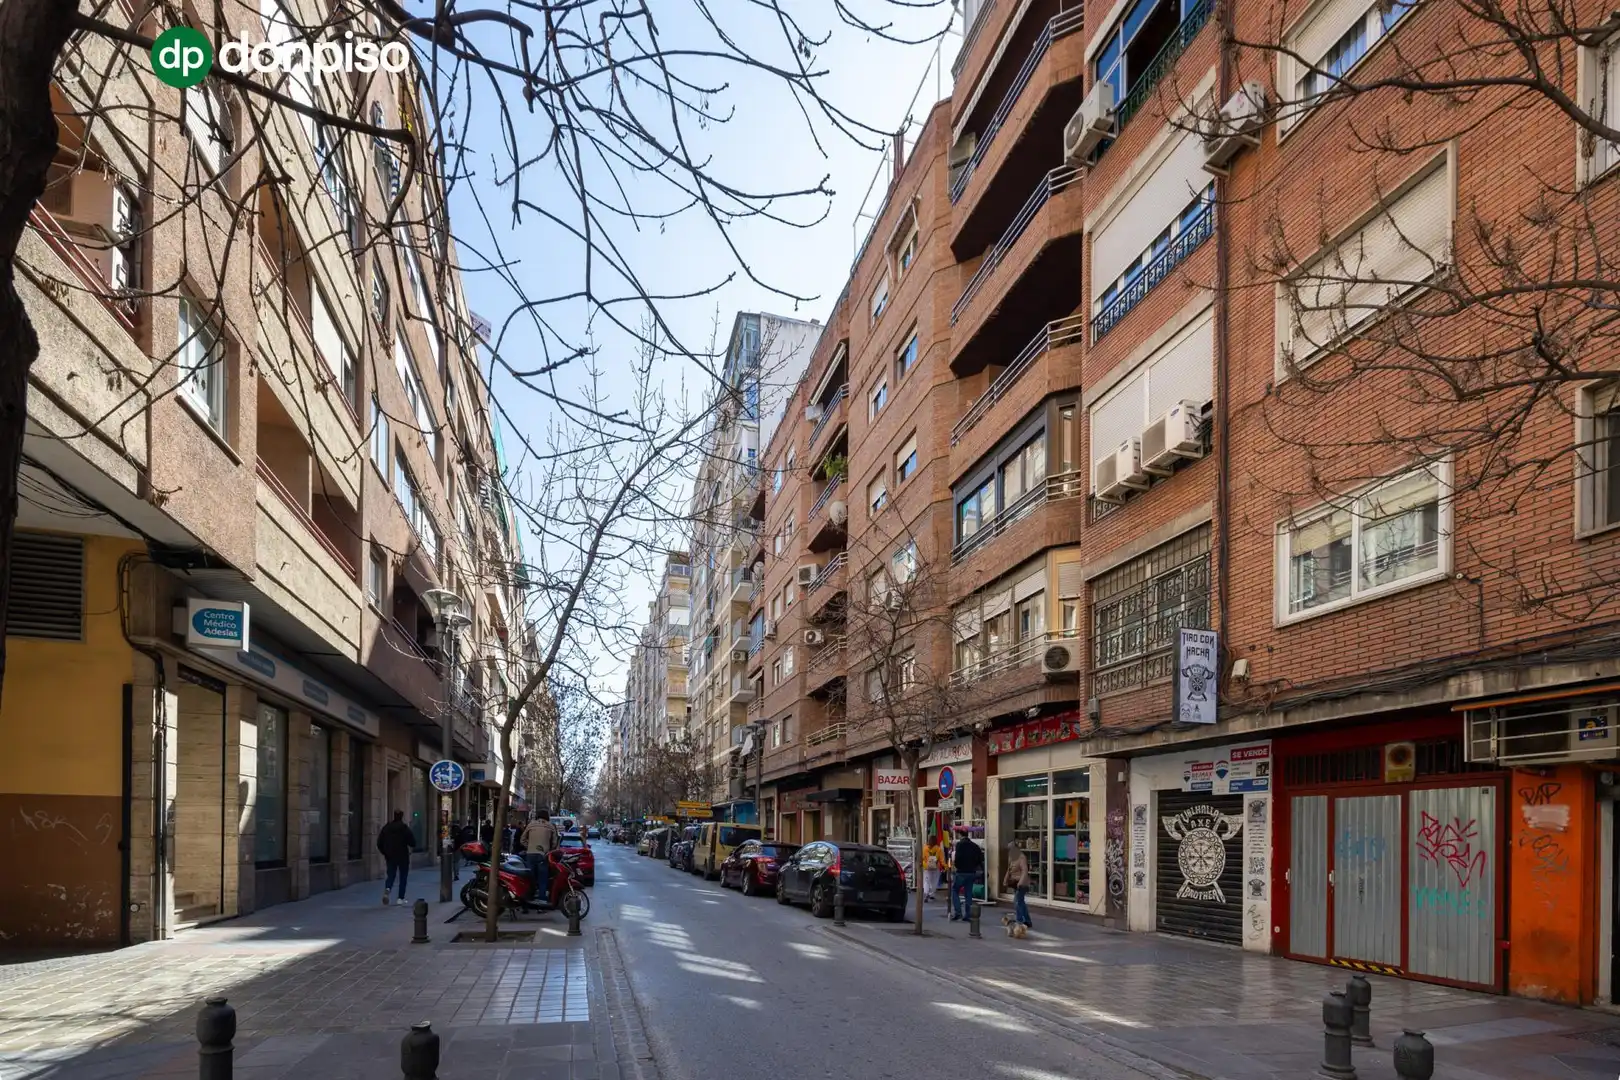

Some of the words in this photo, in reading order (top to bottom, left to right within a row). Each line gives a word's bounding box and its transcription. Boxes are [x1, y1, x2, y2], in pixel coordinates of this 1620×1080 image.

[204, 611, 235, 620] Centro
[204, 619, 236, 628] Médico
[204, 628, 238, 637] Adeslas
[1199, 634, 1215, 648] CON
[1186, 646, 1210, 661] HACHA
[1232, 751, 1242, 759] SE
[1244, 748, 1268, 758] VENDE
[878, 775, 911, 785] BAZAR
[1180, 804, 1220, 823] VALHALLA
[1191, 819, 1212, 829] AXE
[1181, 887, 1221, 903] BROTHER
